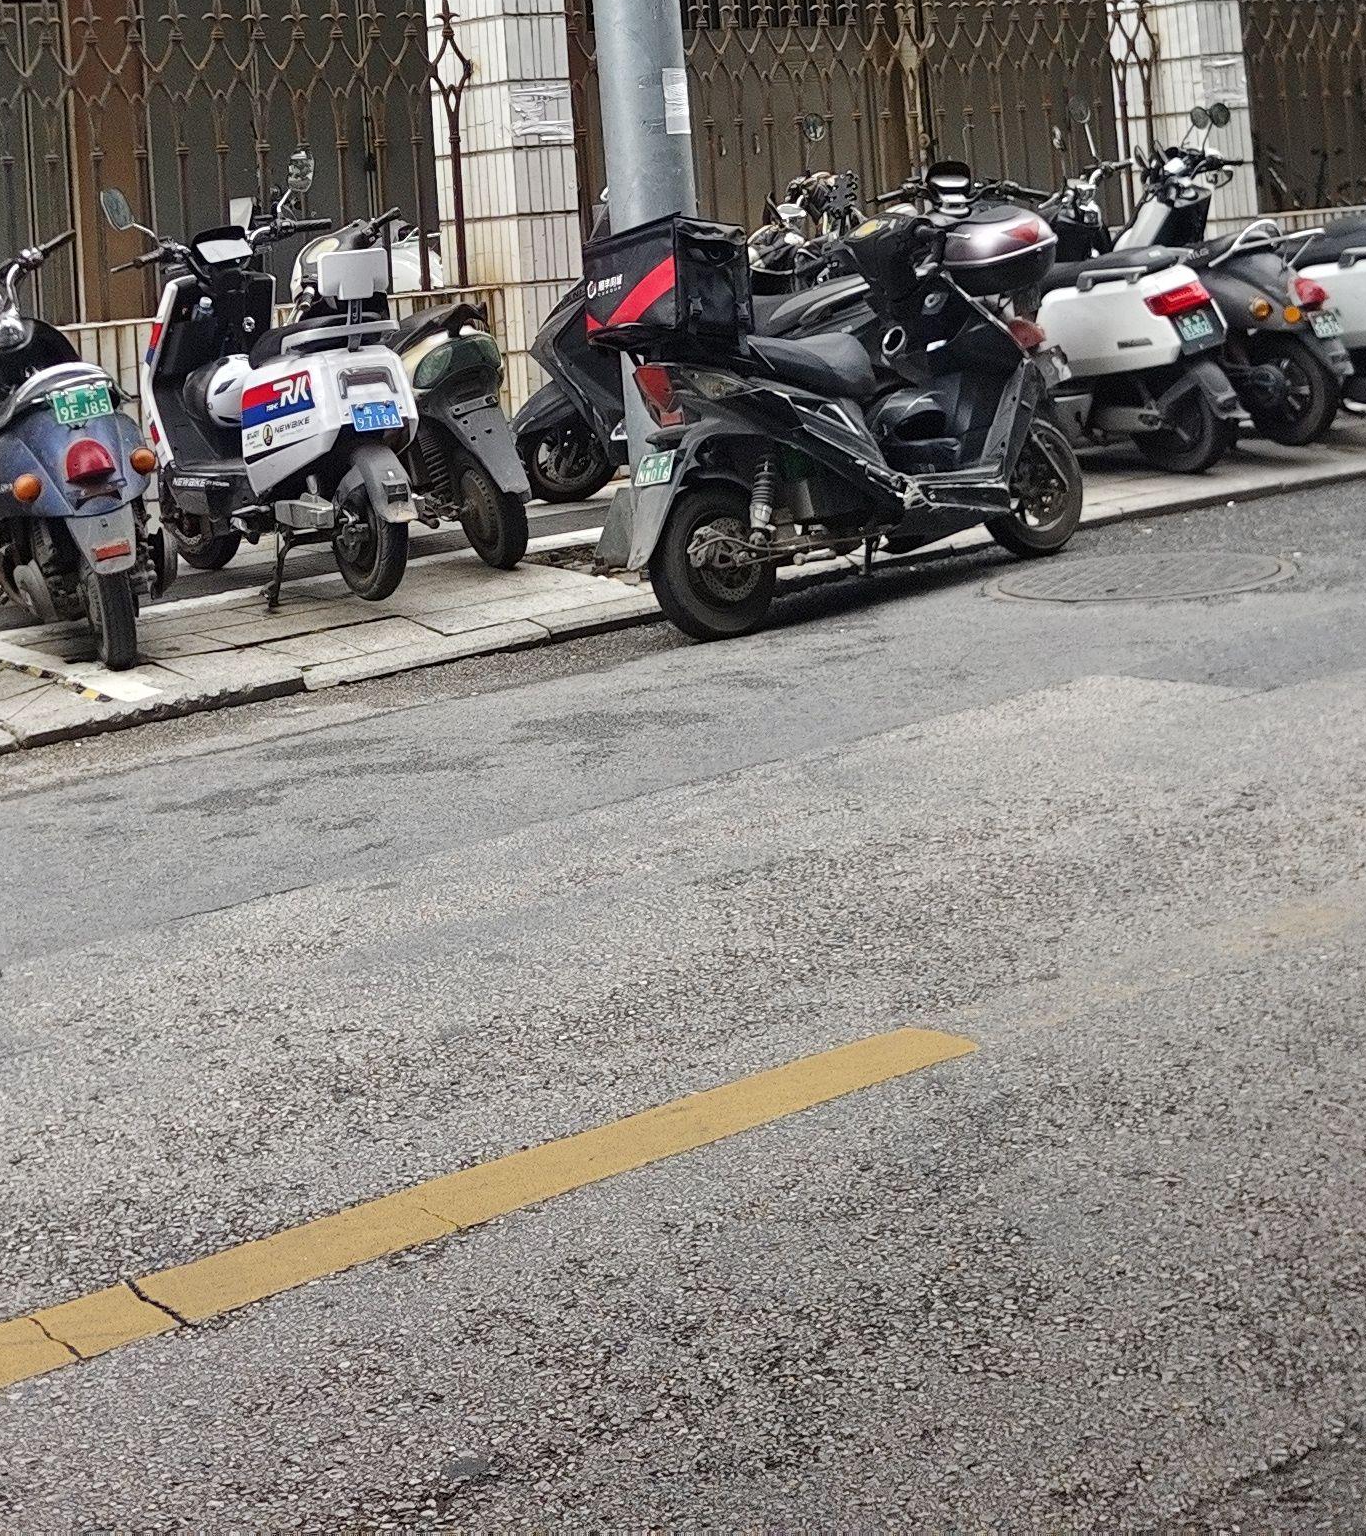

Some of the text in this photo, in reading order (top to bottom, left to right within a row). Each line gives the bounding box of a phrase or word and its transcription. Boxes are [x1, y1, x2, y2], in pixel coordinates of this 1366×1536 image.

[60, 399, 110, 421] 9FJ85
[275, 416, 310, 433] NEWBIKE
[358, 413, 400, 429] 9718A
